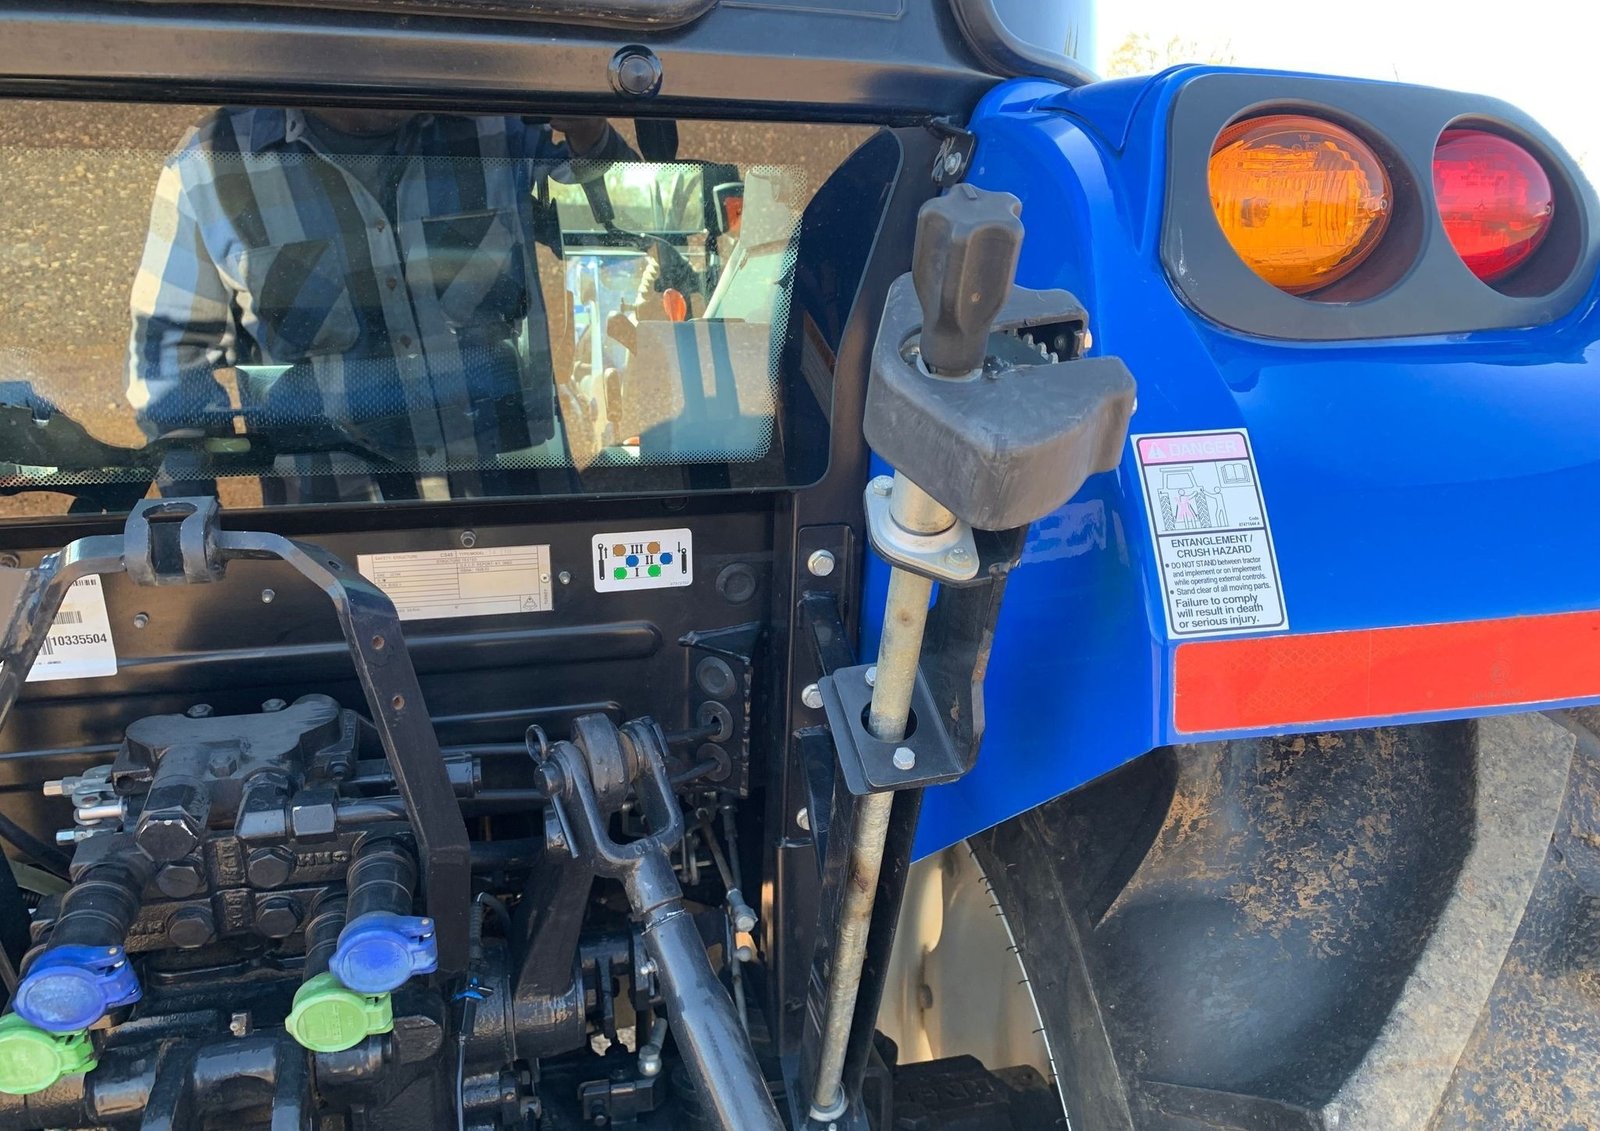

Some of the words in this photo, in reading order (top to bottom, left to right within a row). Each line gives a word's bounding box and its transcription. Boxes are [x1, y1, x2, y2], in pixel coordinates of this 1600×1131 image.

[1168, 440, 1236, 456] DANGER
[1171, 534, 1248, 548] ENTANGLEMENT
[630, 544, 643, 554] III
[1176, 547, 1211, 558] CRUSH
[1212, 544, 1252, 556] HAZARD
[645, 555, 654, 564] II
[1182, 561, 1195, 569] NOT
[1195, 559, 1217, 568] STAND
[1217, 558, 1242, 566] between
[1242, 556, 1261, 564] tractor
[1172, 570, 1184, 578] and
[1185, 568, 1216, 578] implement
[1232, 565, 1262, 575] implement
[1174, 578, 1190, 586] while
[1190, 576, 1218, 587] operating
[1218, 574, 1241, 583] external
[1242, 572, 1267, 580] controls.
[1176, 586, 1195, 596] Stand
[1196, 585, 1212, 594] clear
[1213, 585, 1220, 593] of
[1220, 584, 1229, 593] all
[1229, 583, 1253, 592] moving
[1253, 581, 1271, 591] parts.
[1175, 598, 1209, 608] Failure
[1210, 597, 1220, 605] to
[1222, 593, 1258, 605] comply
[1176, 609, 1194, 618] will
[1195, 606, 1223, 617] result
[1225, 605, 1235, 614] in
[1236, 603, 1264, 614] death
[1179, 621, 1189, 629] or
[1191, 618, 1228, 627] serious
[1229, 615, 1260, 626] injury.
[51, 633, 108, 646] 10335504
